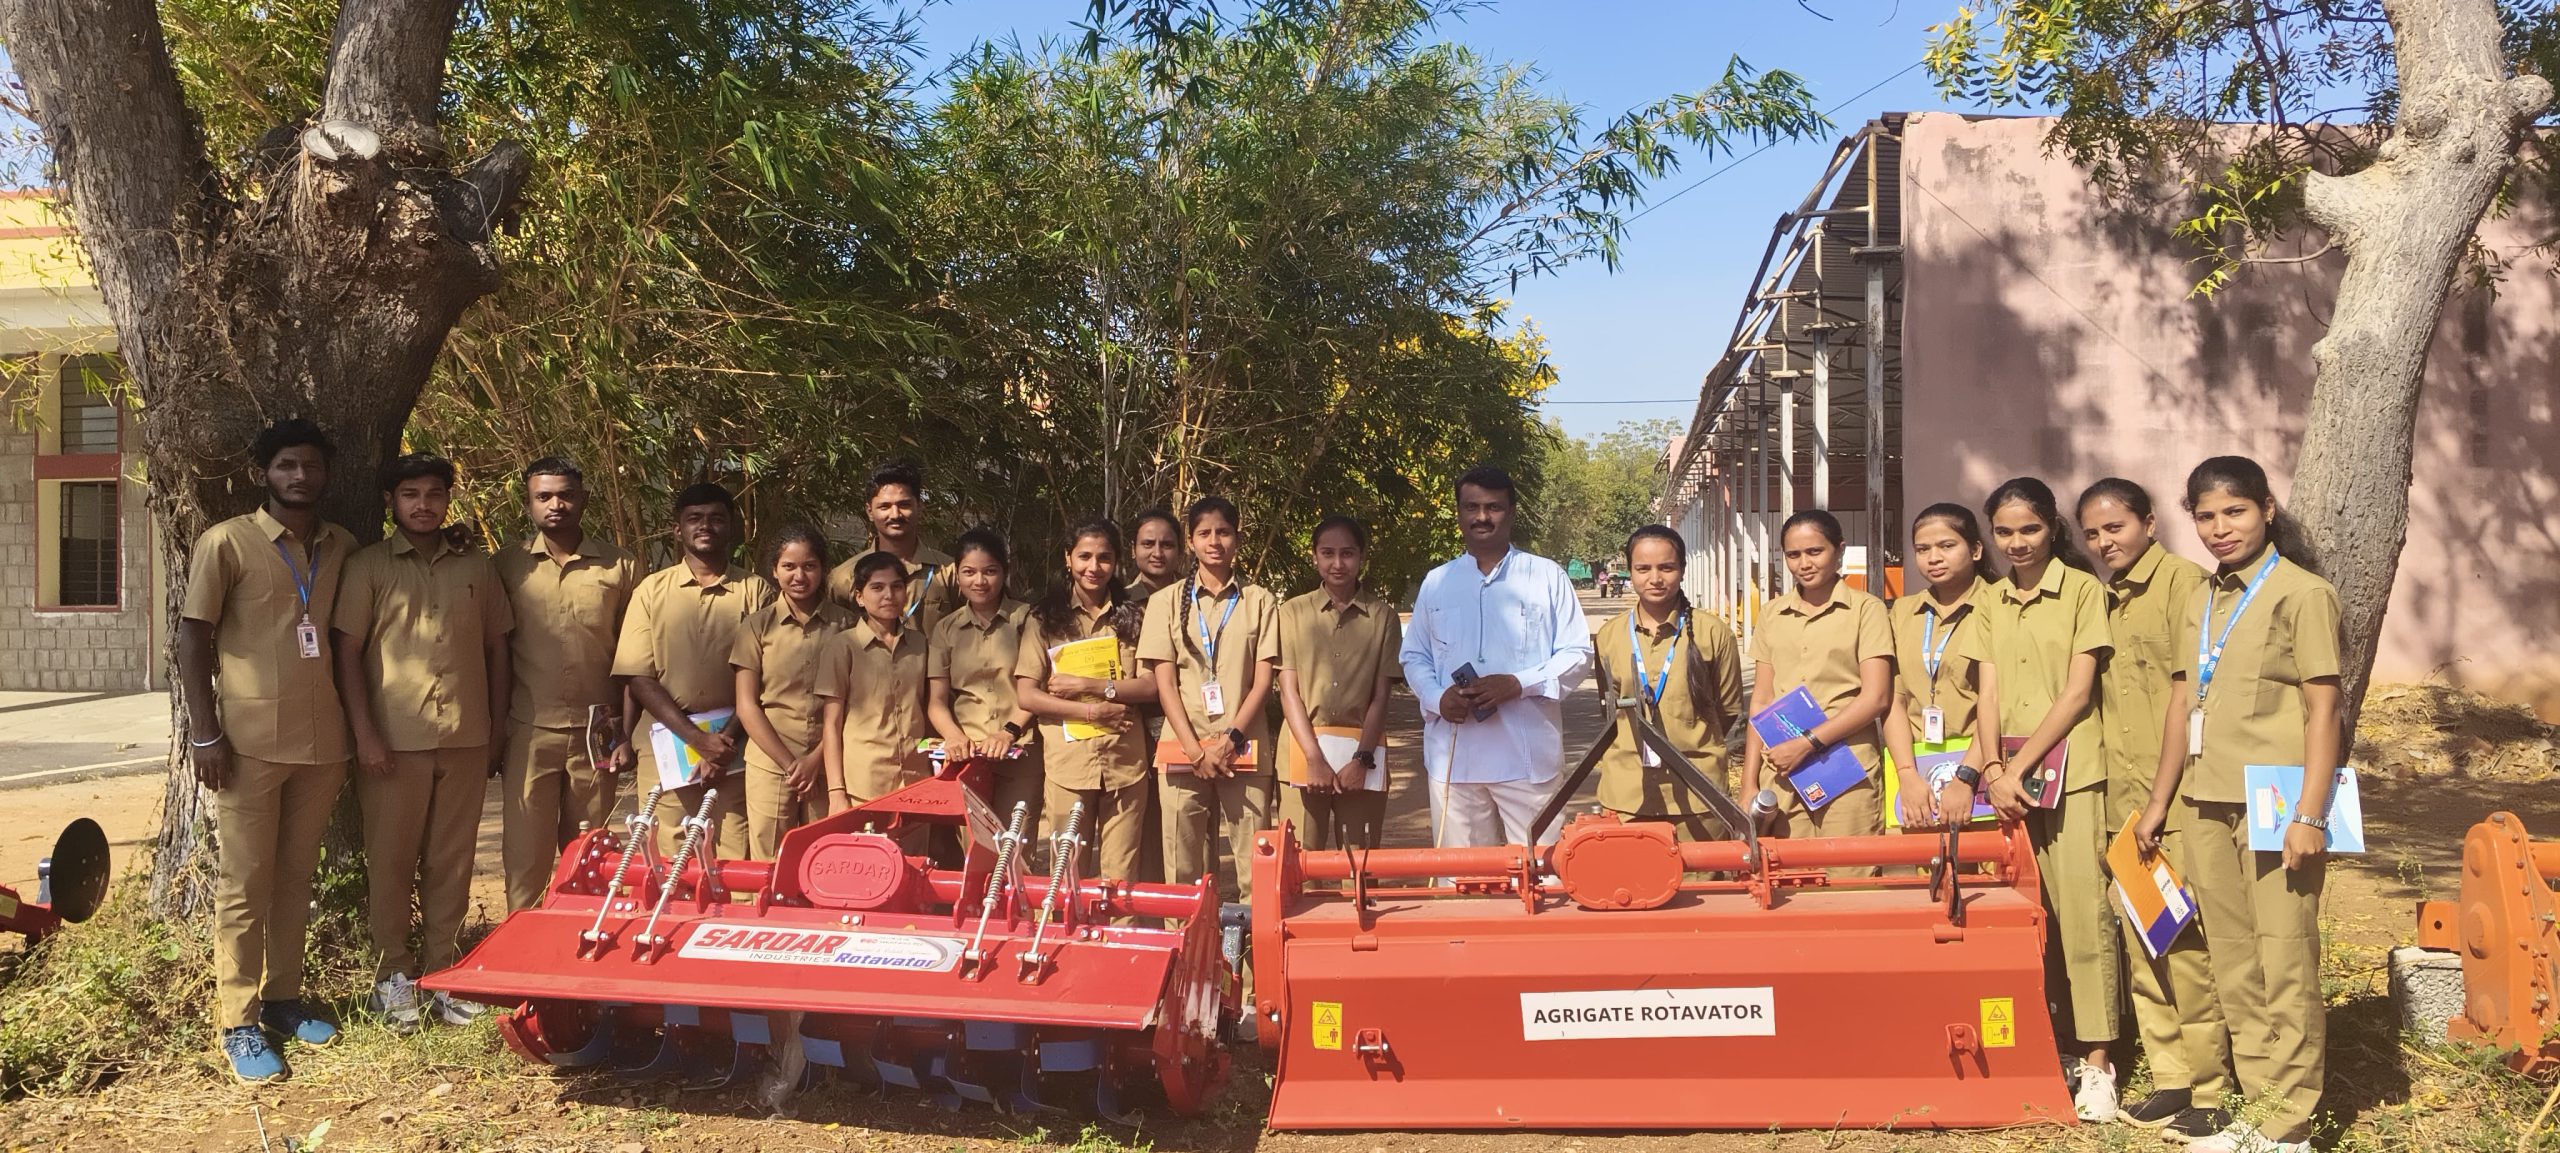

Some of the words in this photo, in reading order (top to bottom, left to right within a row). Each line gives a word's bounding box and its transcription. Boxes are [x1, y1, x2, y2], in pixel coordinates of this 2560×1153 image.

[812, 860, 891, 881] SARDAR
[694, 928, 849, 954] SARDAR
[749, 952, 831, 963] INDUSTRIES
[834, 952, 936, 968] Rotavator
[1533, 1007, 1635, 1024] AGRIGATE
[1641, 1004, 1764, 1021] ROTAVATOR
